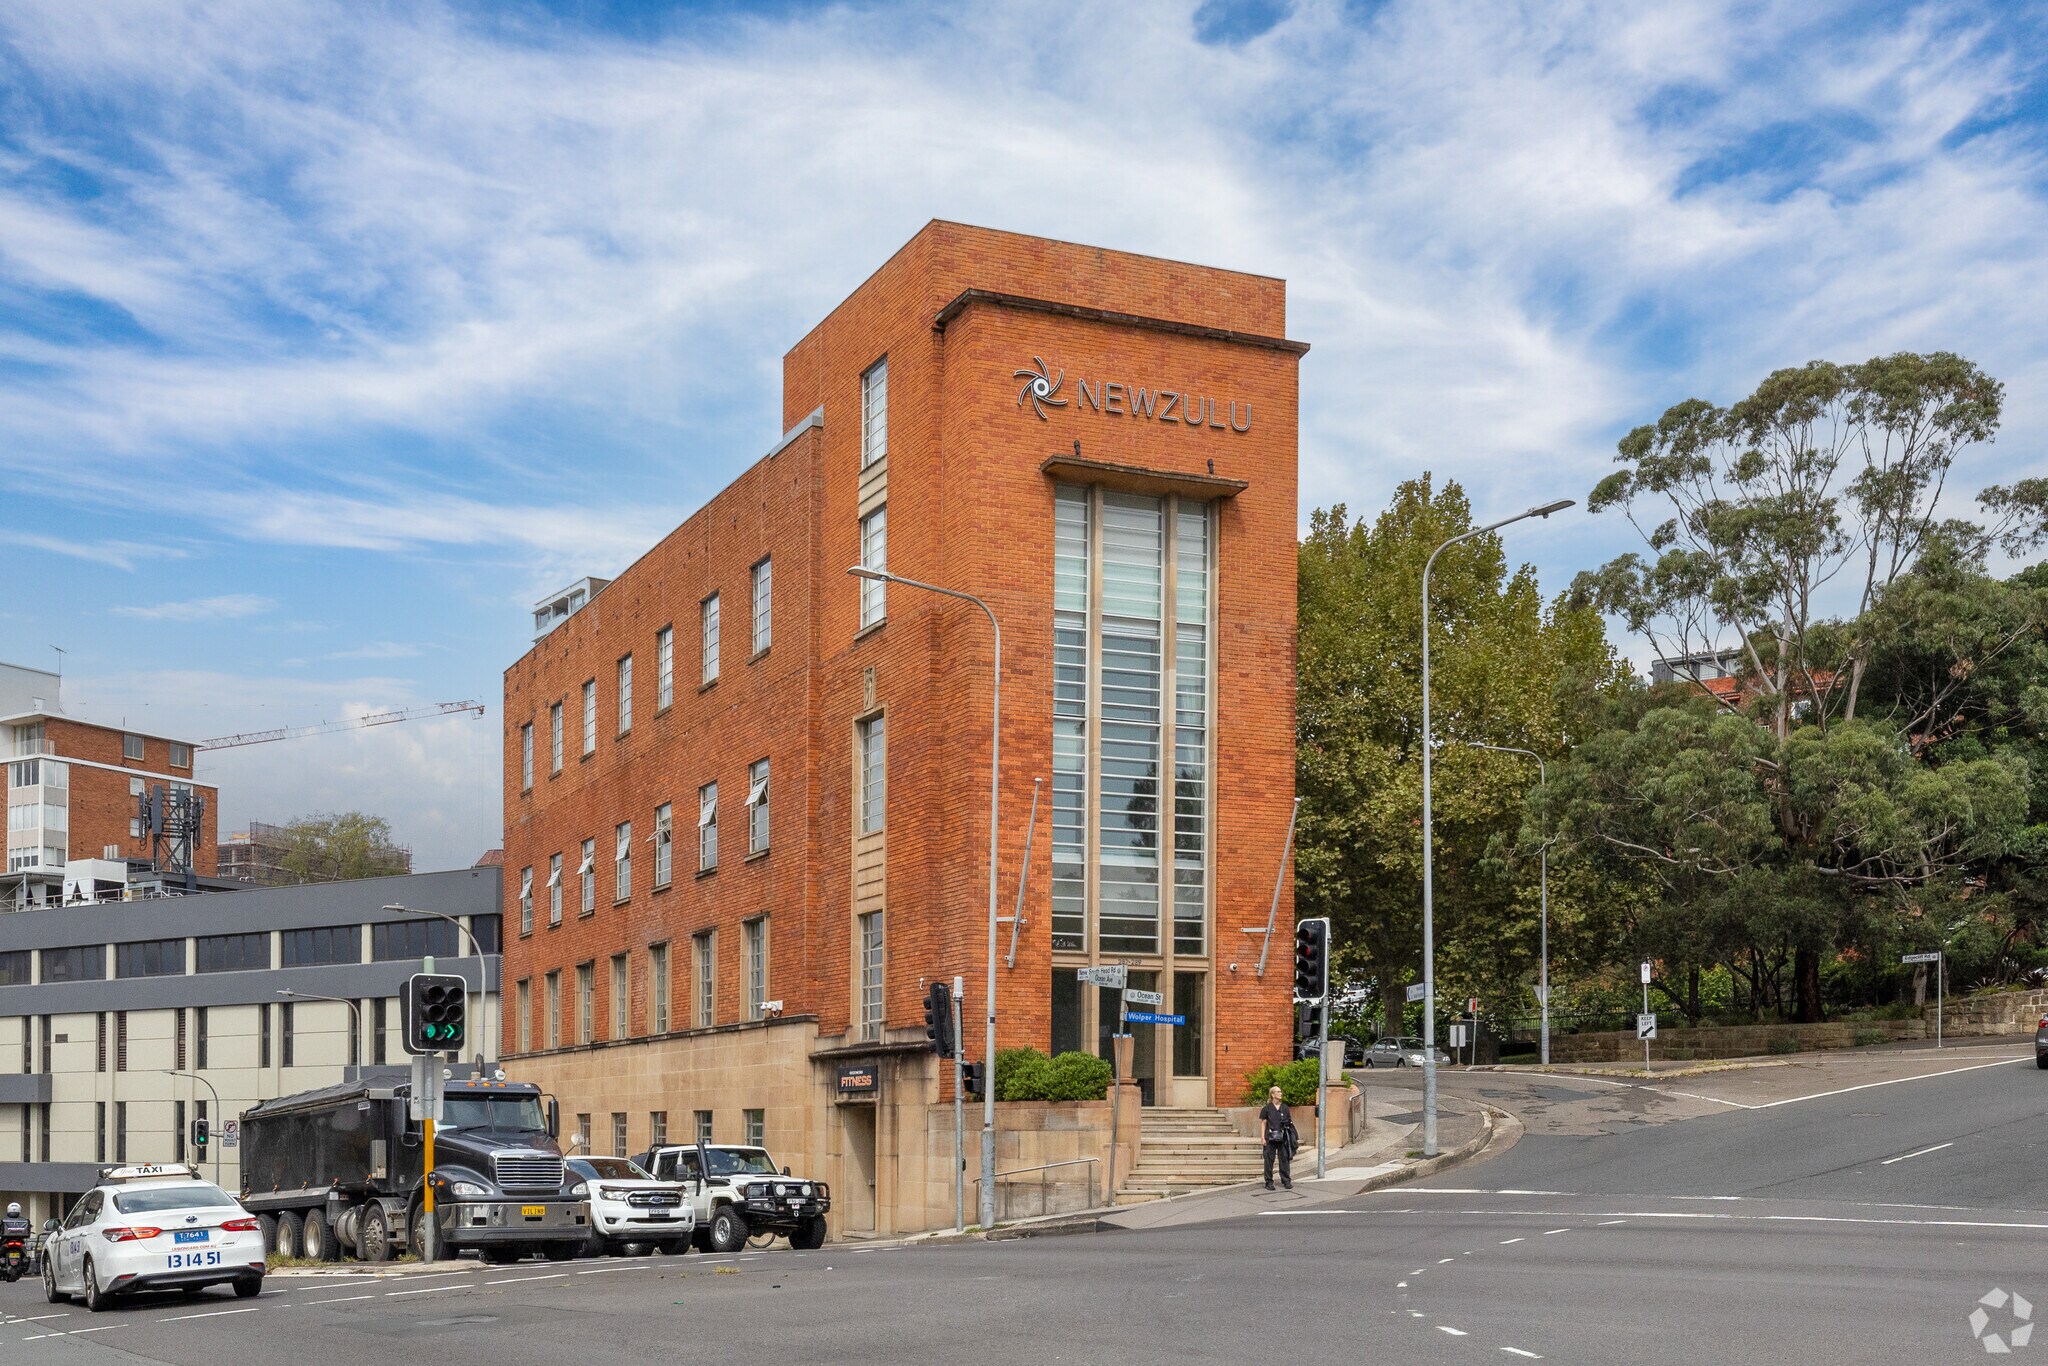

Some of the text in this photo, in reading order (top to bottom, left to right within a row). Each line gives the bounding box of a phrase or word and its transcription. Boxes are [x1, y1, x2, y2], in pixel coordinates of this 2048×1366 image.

[1078, 378, 1252, 432] NEWZULU
[1111, 966, 1117, 974] Rd
[1095, 974, 1106, 982] Ocean
[1137, 991, 1162, 1001] Ocean St
[1128, 1012, 1183, 1024] Wolper Hospital
[841, 1075, 872, 1087] FITNESS
[136, 1166, 163, 1174] TAXI
[168, 1251, 221, 1268] 13 14 51
